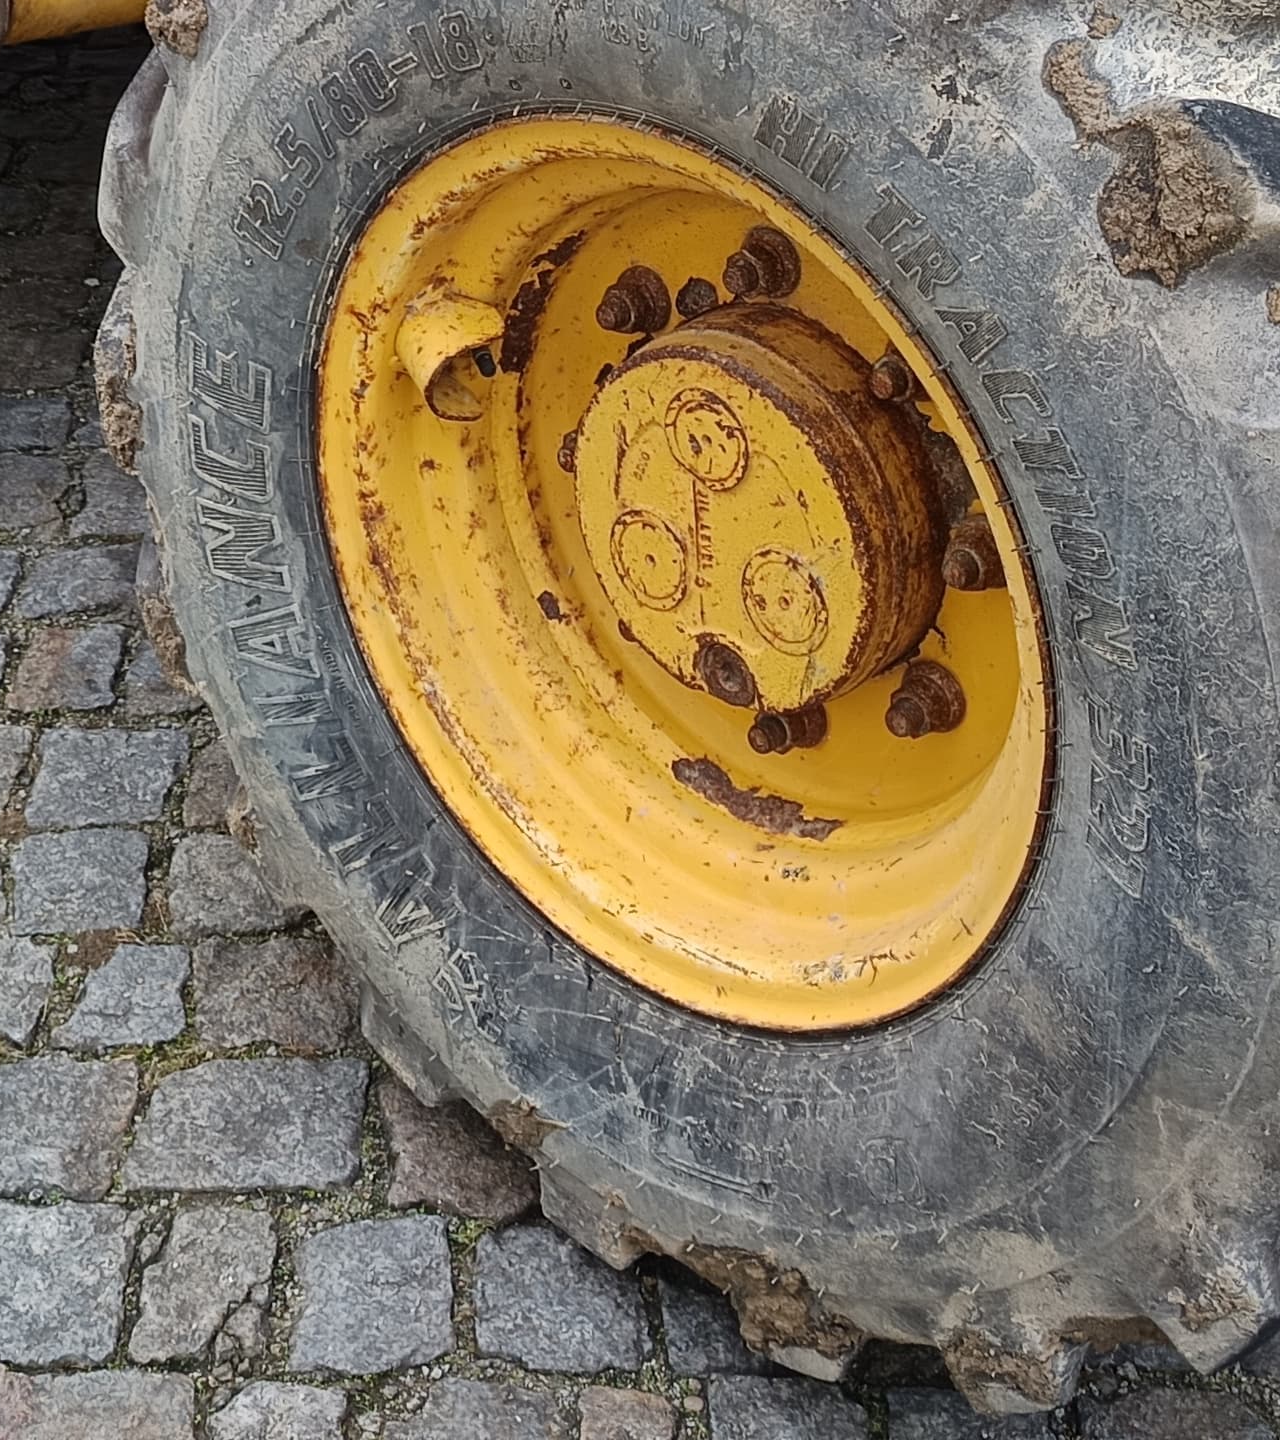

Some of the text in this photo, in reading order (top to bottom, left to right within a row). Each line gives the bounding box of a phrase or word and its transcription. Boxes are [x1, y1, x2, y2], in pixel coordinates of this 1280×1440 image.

[232, 10, 484, 260] 12.5/80-18
[187, 330, 462, 948] ALLIANCE
[752, 96, 1154, 901] HI TRACTION 321
